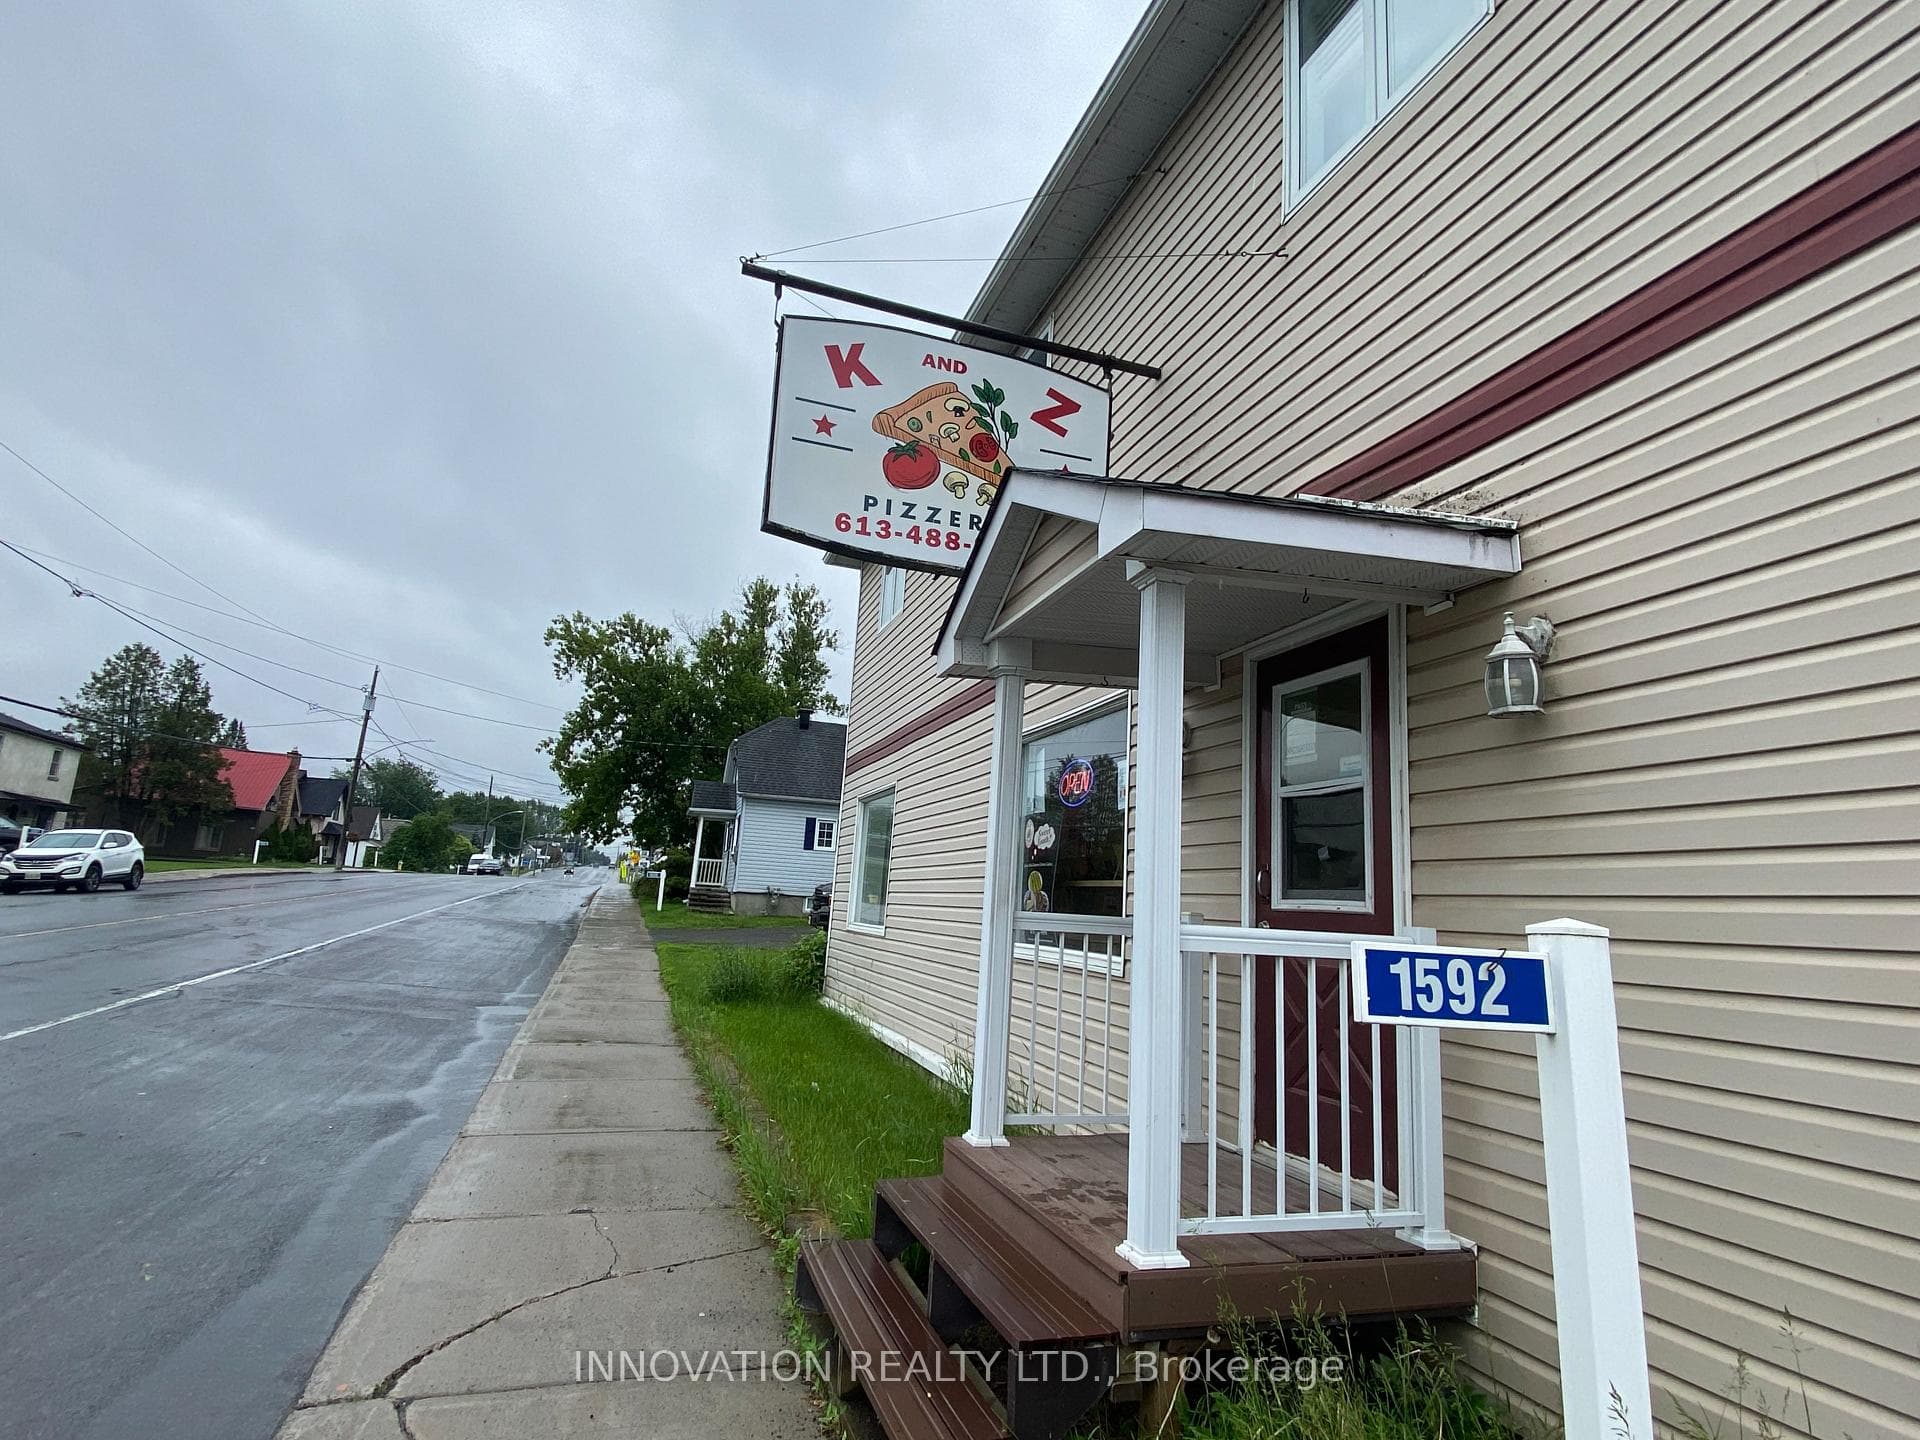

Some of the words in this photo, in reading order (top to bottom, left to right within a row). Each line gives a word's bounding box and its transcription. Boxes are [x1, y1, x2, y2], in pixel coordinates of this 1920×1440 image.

[824, 342, 883, 389] K
[921, 353, 968, 375] AND
[1029, 387, 1082, 438] Z
[834, 512, 972, 551] 613-488-
[863, 494, 983, 531] PIZZER
[1060, 769, 1091, 797] OPEN
[1389, 957, 1510, 1016] 1592
